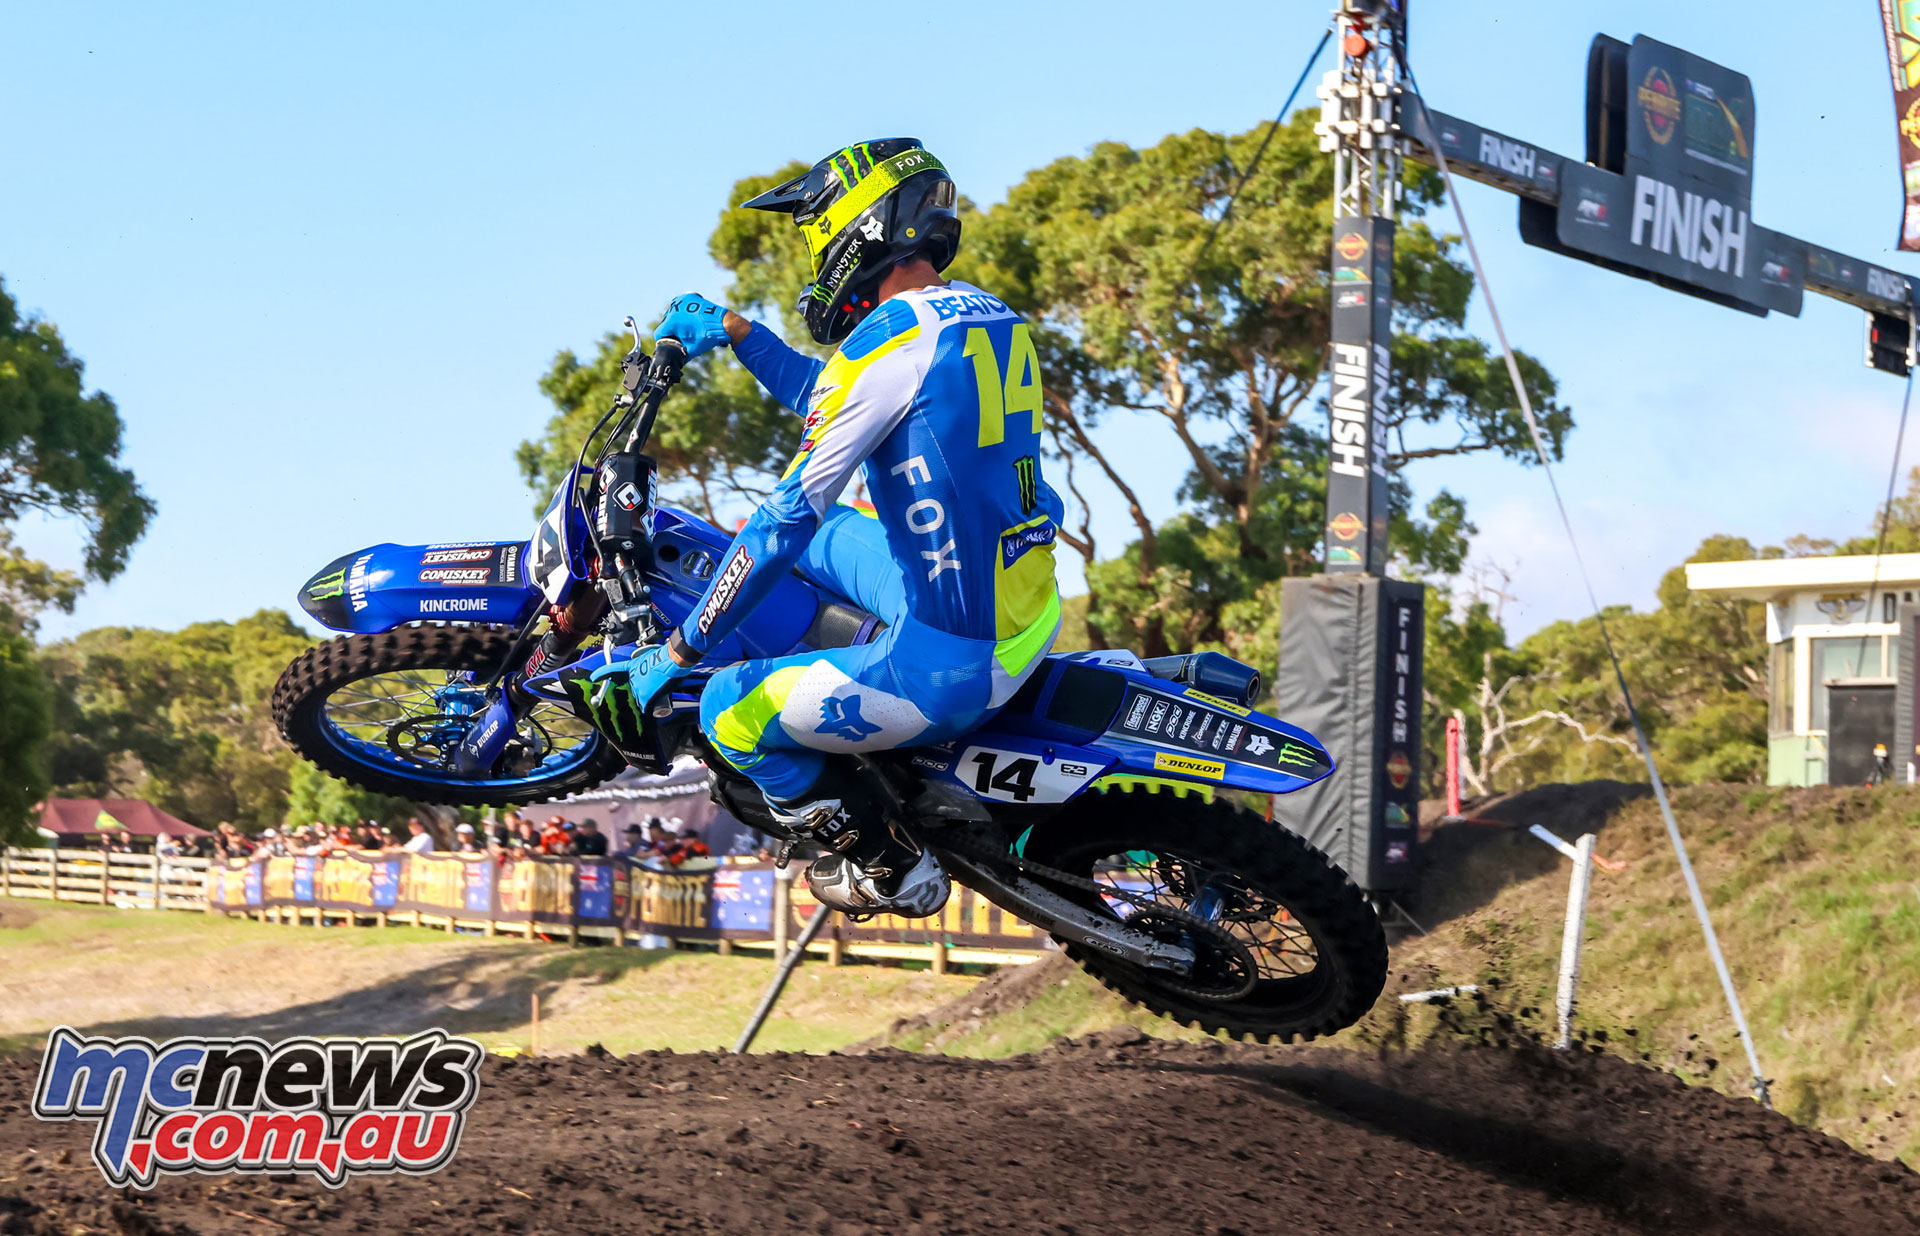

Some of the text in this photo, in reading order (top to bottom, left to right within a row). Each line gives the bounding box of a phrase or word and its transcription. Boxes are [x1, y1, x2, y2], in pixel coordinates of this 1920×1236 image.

[895, 153, 925, 171] FOX
[1479, 133, 1536, 179] FINISH
[1631, 175, 1747, 278] FINISH
[826, 238, 863, 289] MONSTER
[1867, 268, 1908, 302] FINIS
[670, 299, 717, 315] FOX
[962, 323, 1044, 448] 14
[1331, 343, 1368, 478] FINISH
[1371, 343, 1391, 478] FINISH
[891, 454, 962, 582] FOX
[421, 550, 491, 564] COMISKEY
[506, 552, 517, 582] YAMAHA
[350, 552, 374, 613] YAMAHA
[420, 570, 489, 580] COMISKEY
[698, 547, 748, 635] COMISKEY
[721, 559, 754, 613] MINING SERVICES
[420, 598, 488, 613] KINCROME
[524, 644, 547, 678] KYB
[1392, 606, 1411, 743] FINISH
[476, 719, 499, 749] DUNLOP
[1149, 704, 1166, 731] NGK
[1165, 705, 1182, 738] pod
[1178, 710, 1196, 740] KINCROME
[1212, 720, 1229, 750] GYTR
[1225, 723, 1244, 751] YAMALUBE
[971, 751, 1040, 803] 14
[1168, 758, 1222, 774] DUNLOP
[818, 808, 851, 838] FOX
